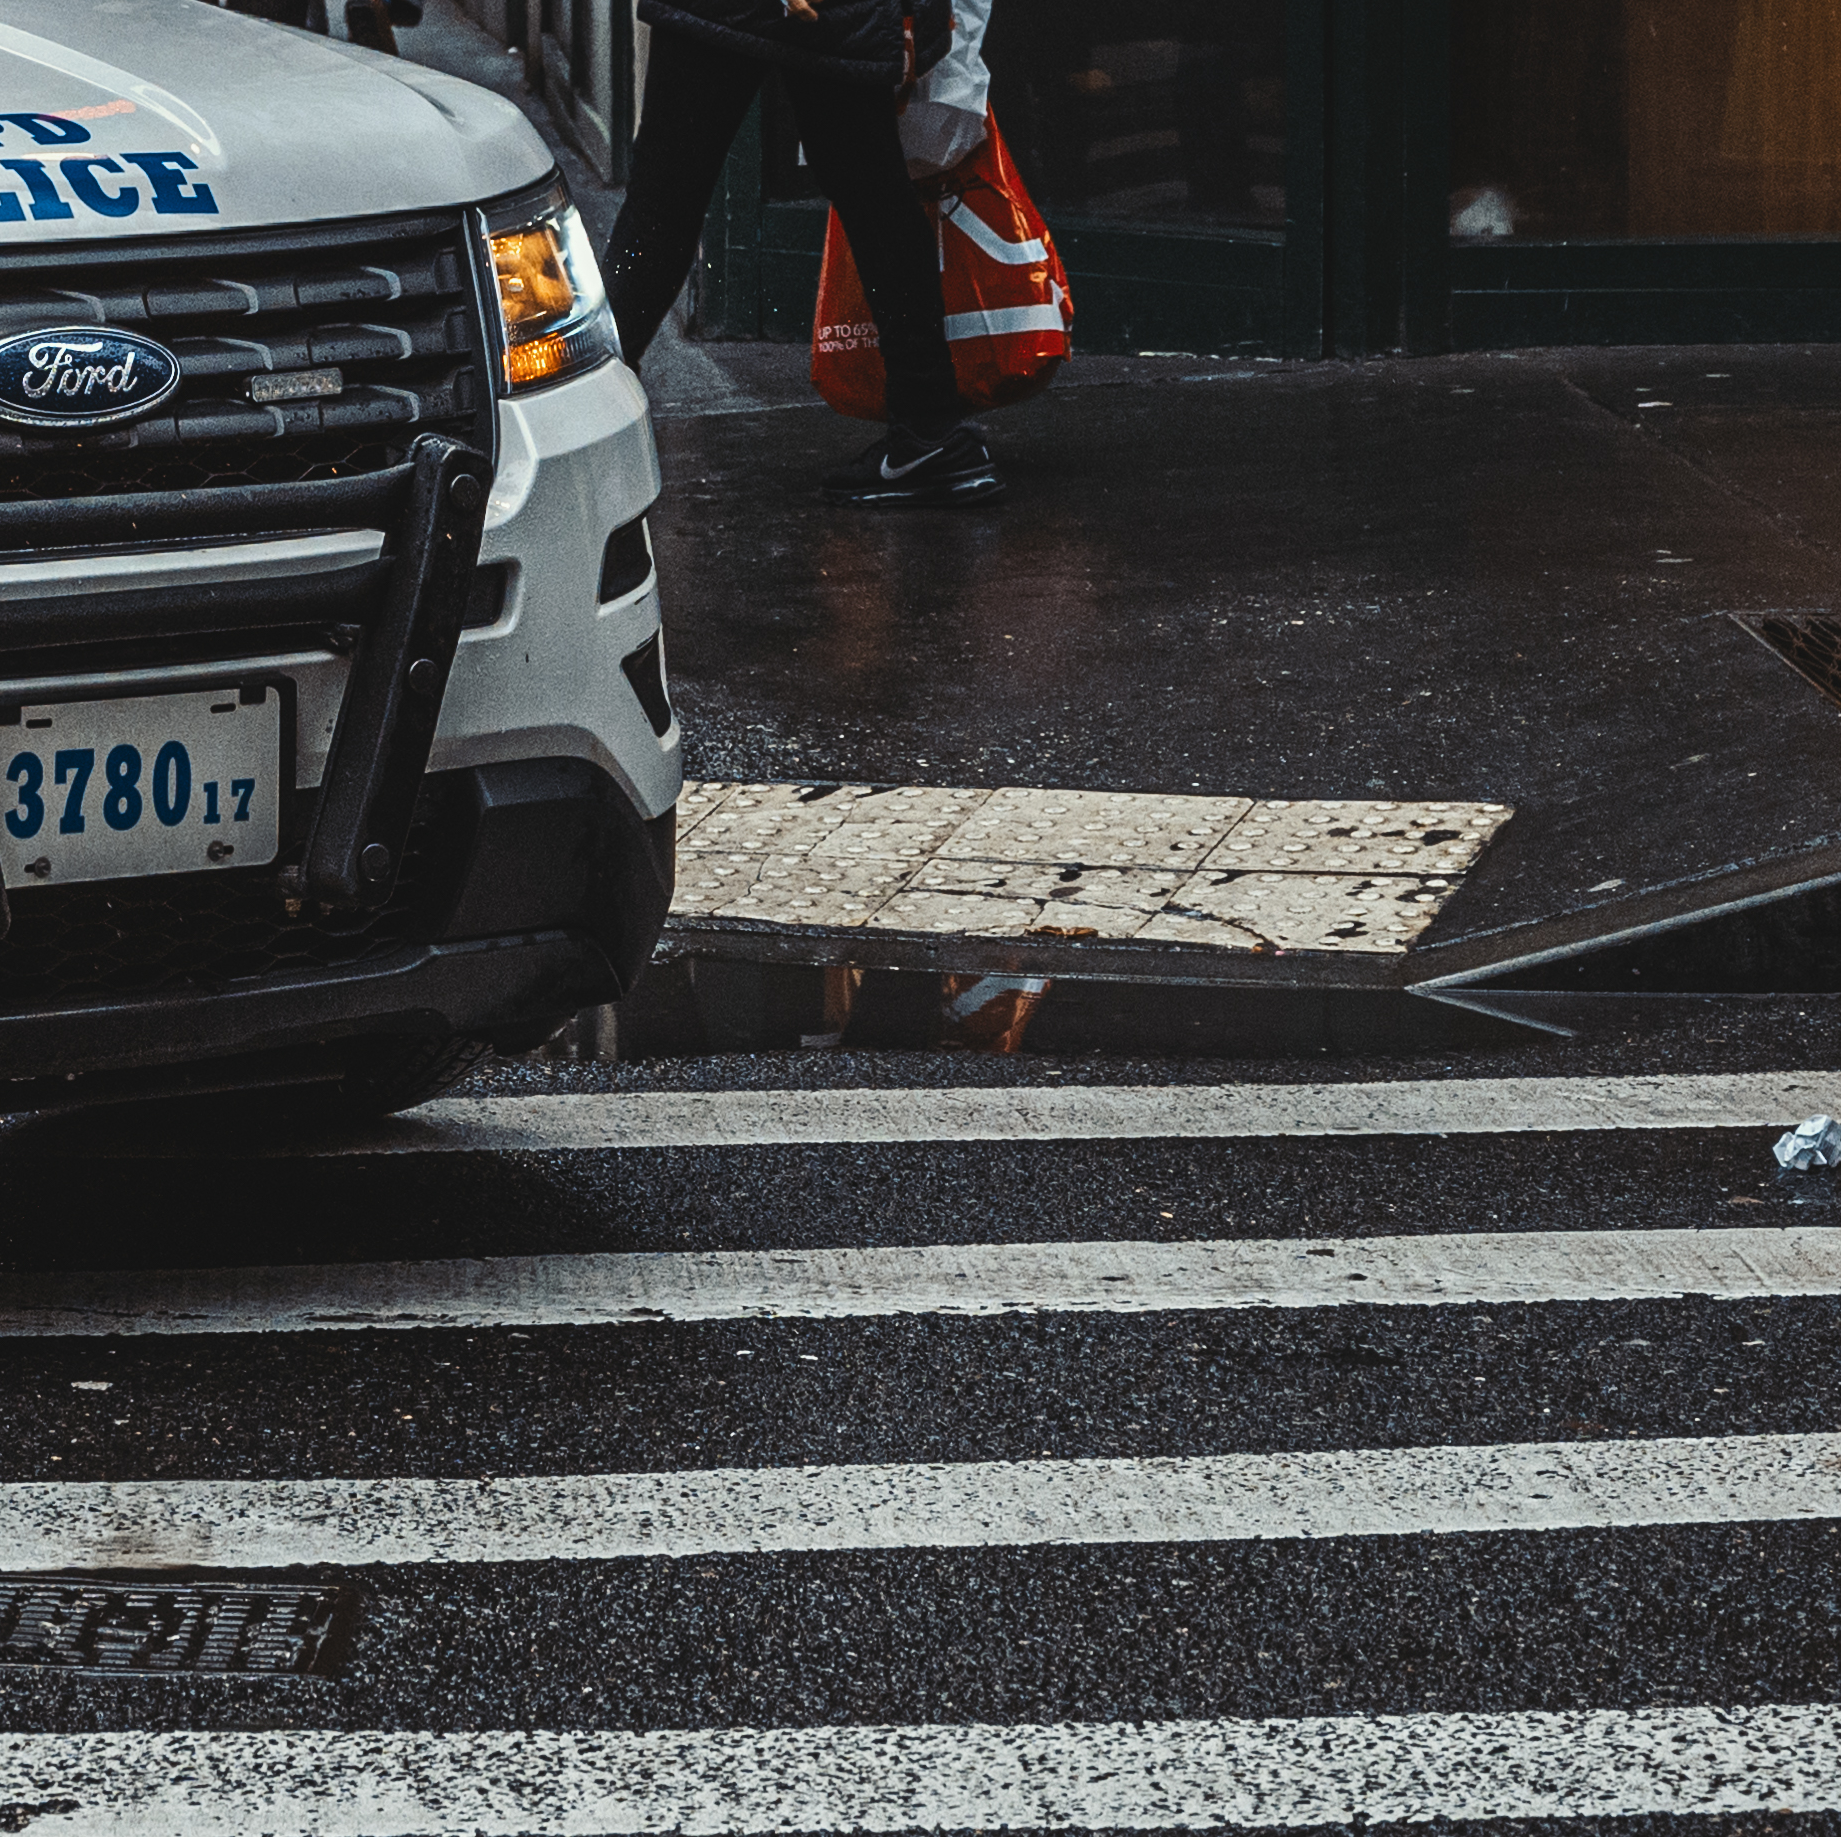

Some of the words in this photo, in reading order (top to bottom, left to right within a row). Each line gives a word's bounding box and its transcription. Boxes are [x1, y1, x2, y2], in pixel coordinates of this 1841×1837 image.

[833, 324, 851, 338] TO
[22, 341, 139, 400] Ford
[4, 740, 193, 840] 3780
[203, 777, 257, 825] 17
